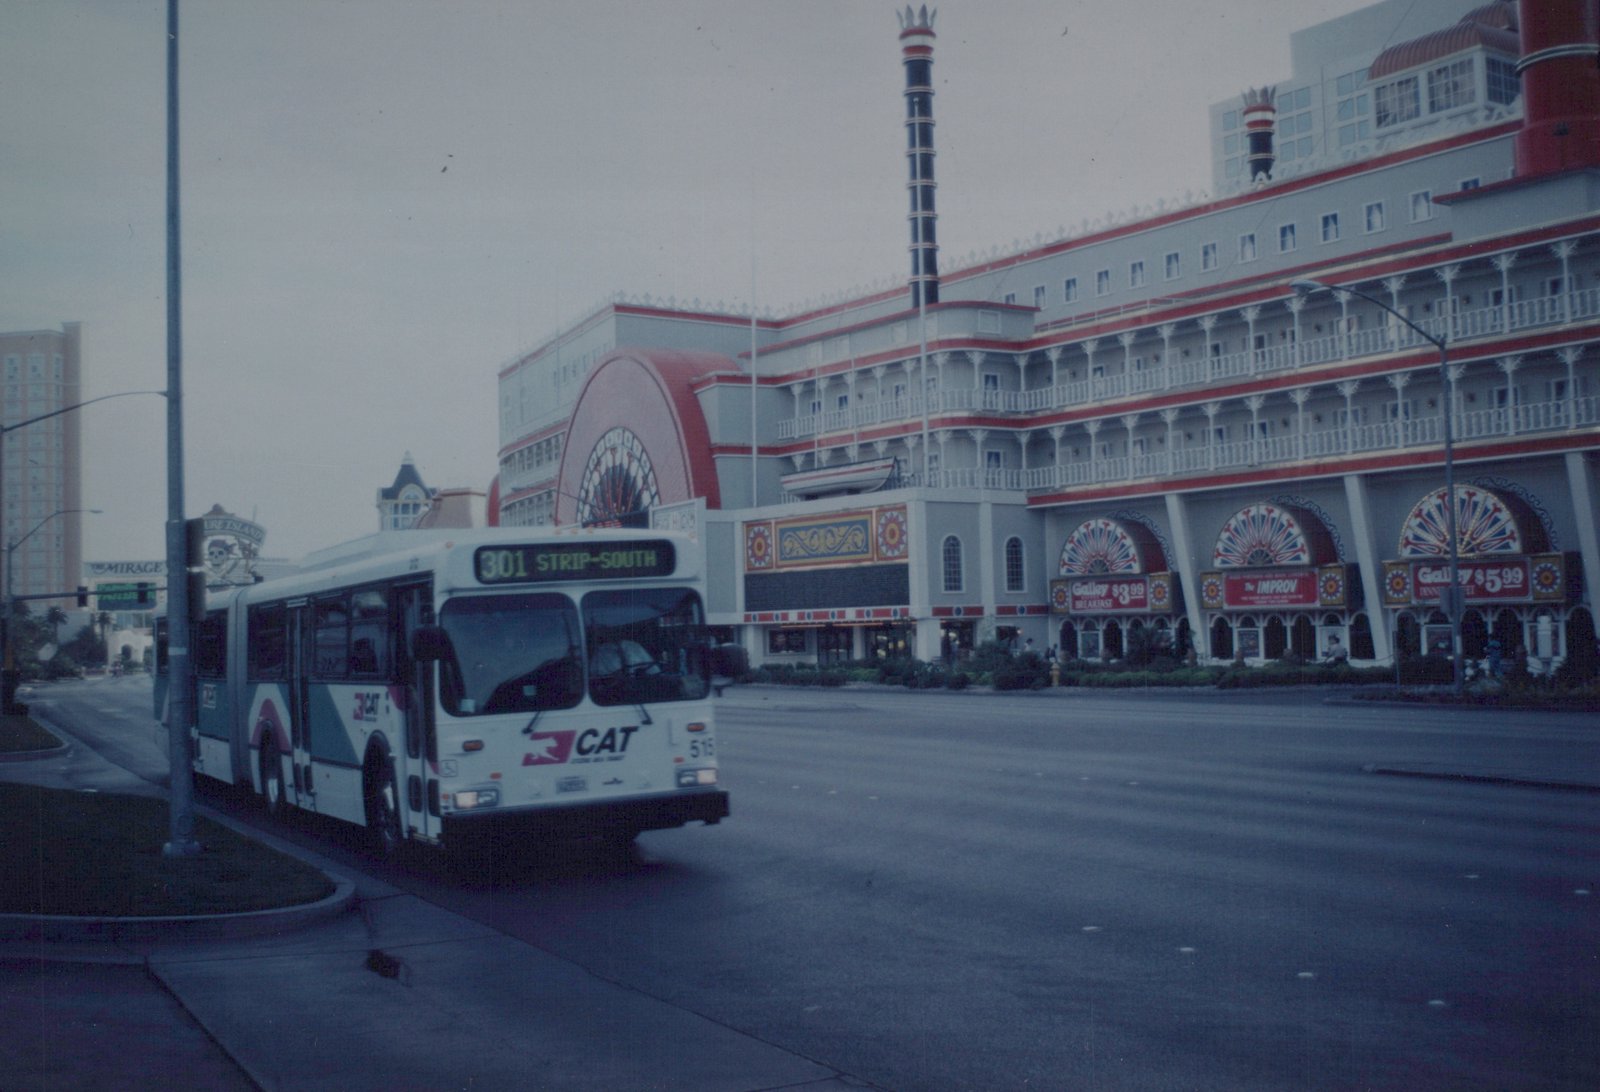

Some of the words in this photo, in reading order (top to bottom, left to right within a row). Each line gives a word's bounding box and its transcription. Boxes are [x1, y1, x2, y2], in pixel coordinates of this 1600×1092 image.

[107, 561, 162, 574] MIRAGE
[480, 550, 527, 578] 301
[537, 550, 657, 572] STRIP-SOUTH
[1072, 581, 1109, 597] Galley
[1257, 579, 1298, 594] IMPROV
[1075, 599, 1112, 609] BREAKFAST
[365, 692, 380, 715] CAT
[577, 726, 639, 755] CAT
